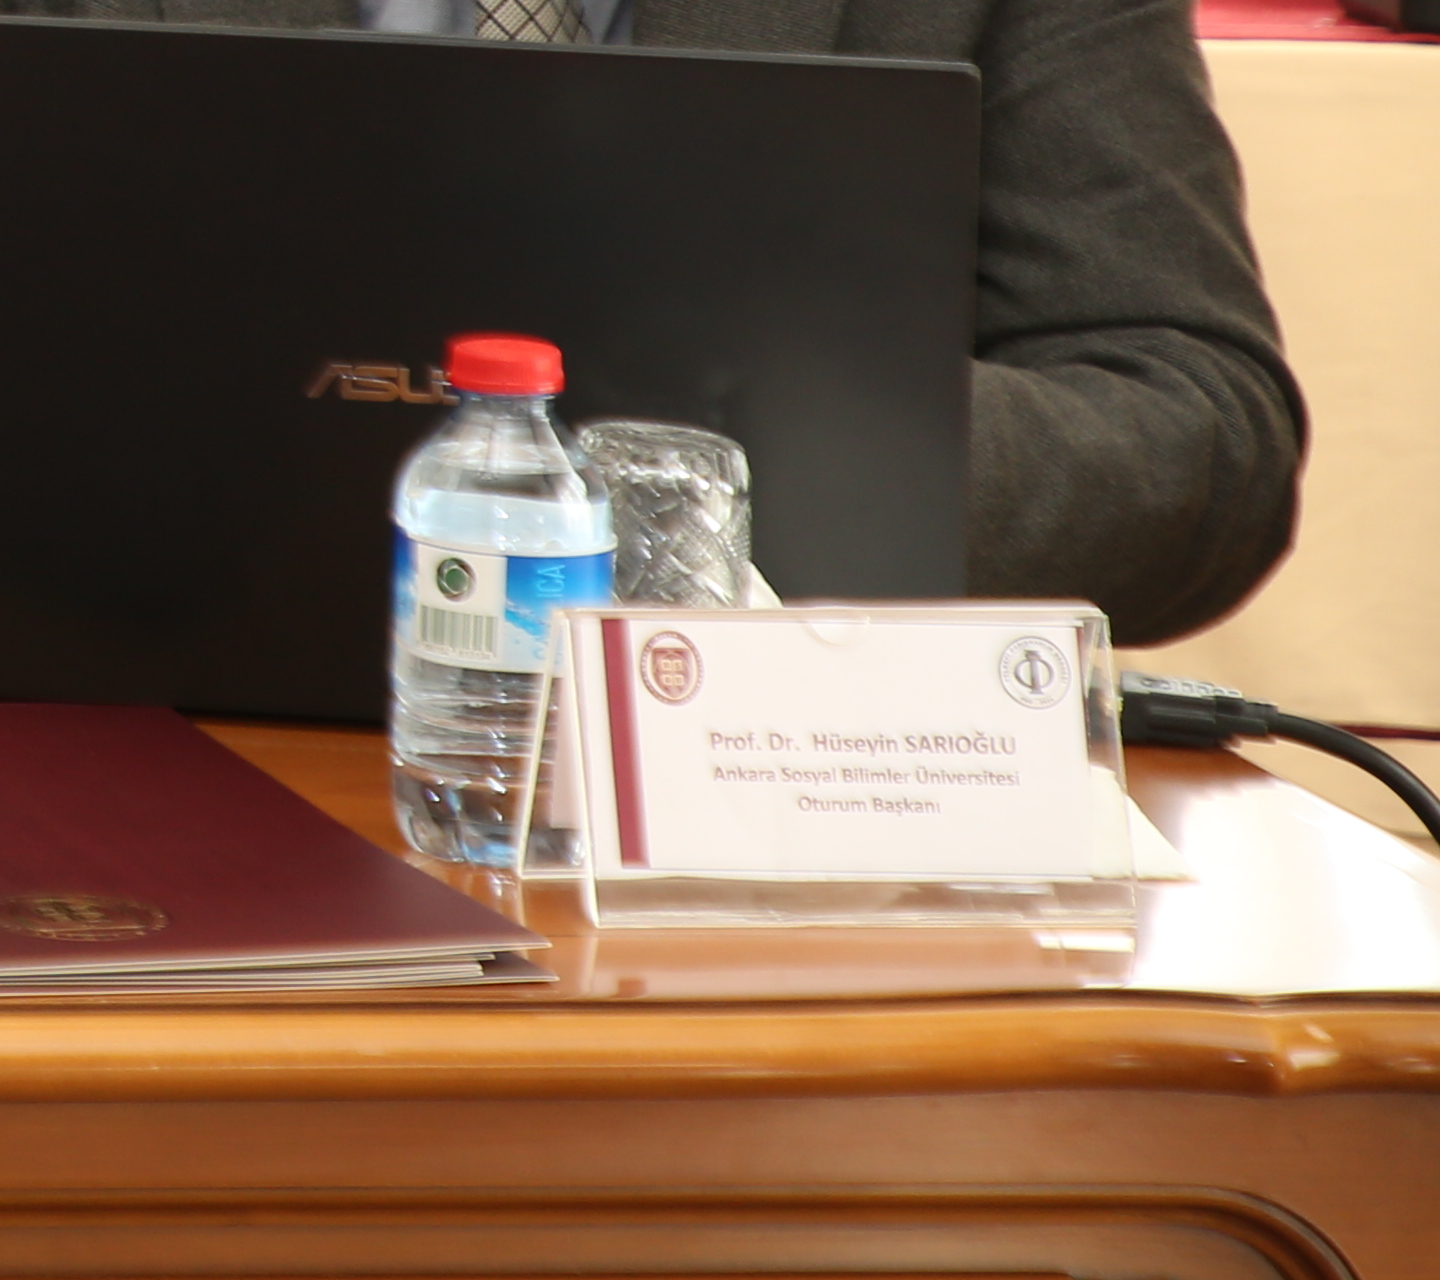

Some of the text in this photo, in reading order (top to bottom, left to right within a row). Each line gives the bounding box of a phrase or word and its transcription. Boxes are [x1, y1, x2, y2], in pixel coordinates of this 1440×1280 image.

[709, 730, 1017, 757] Prof. Dr. Hüseyin SARIOĞLU
[713, 766, 1022, 787] Ankara Sosyal Bilimler Üniversitesi
[798, 796, 942, 817] Oturum Başkanı
